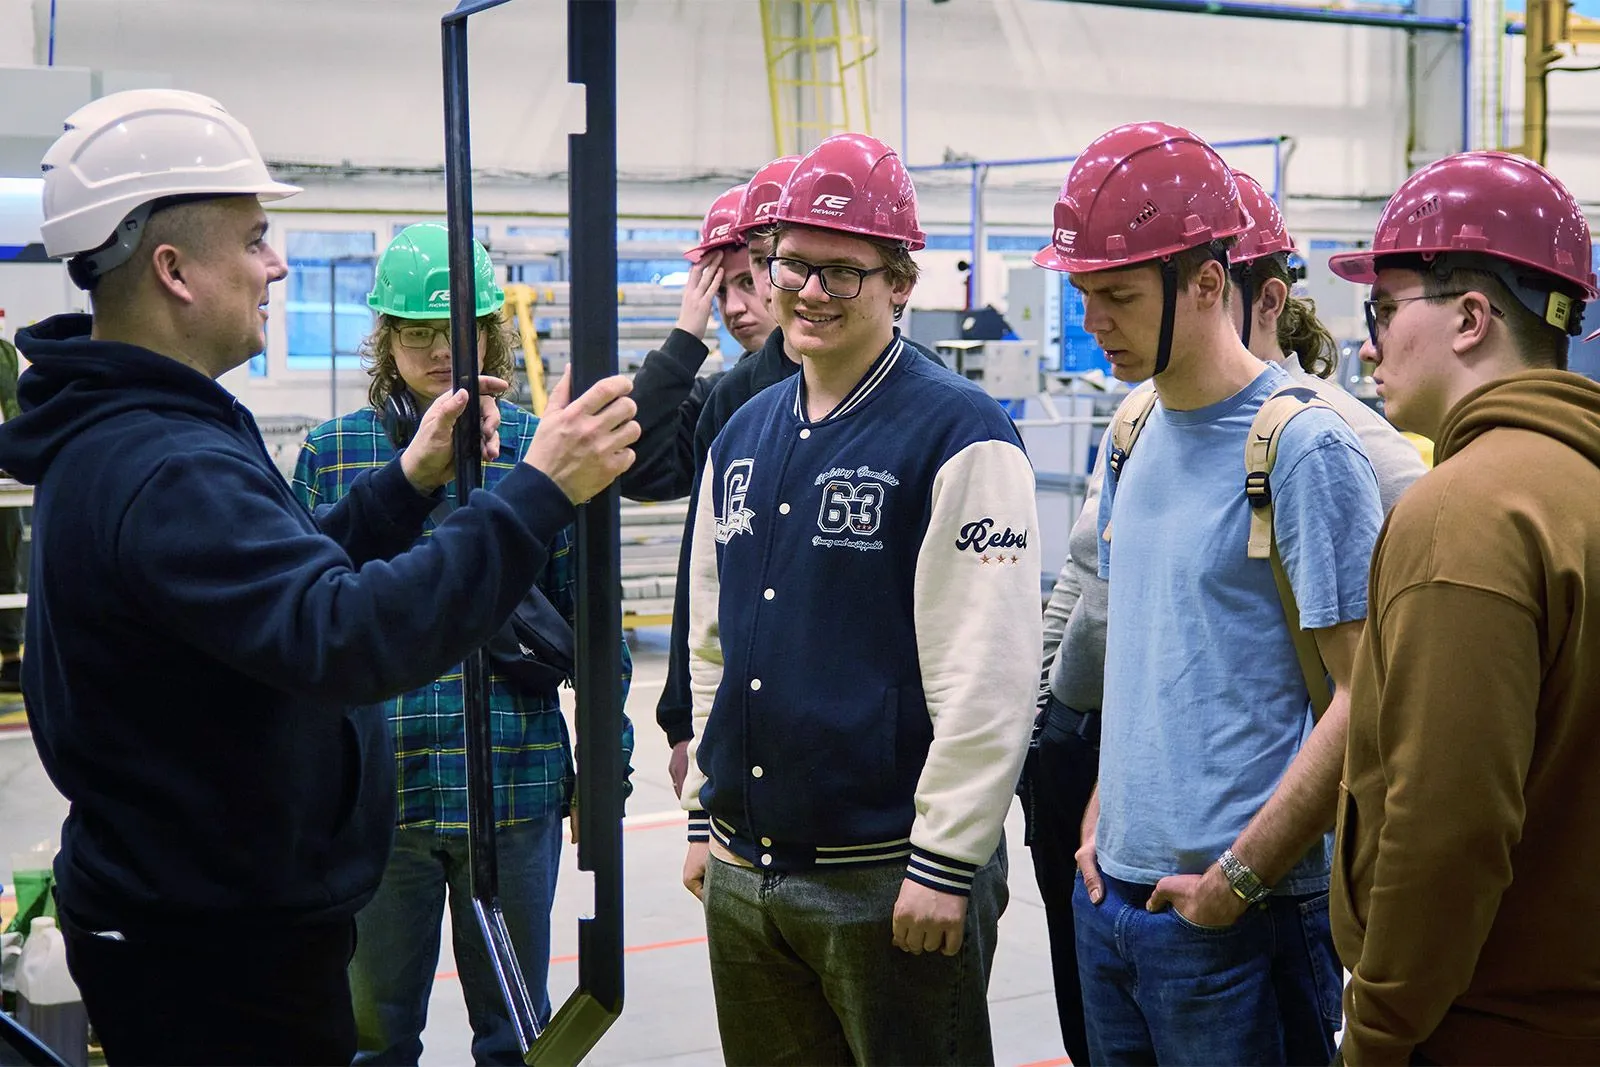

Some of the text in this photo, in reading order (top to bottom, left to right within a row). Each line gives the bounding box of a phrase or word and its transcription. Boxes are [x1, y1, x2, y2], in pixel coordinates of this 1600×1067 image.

[812, 194, 852, 209] RE
[811, 207, 845, 217] REWATT
[817, 480, 884, 536] 63
[812, 535, 884, 552] Young and unstoppable
[955, 518, 1027, 553] Rebel
